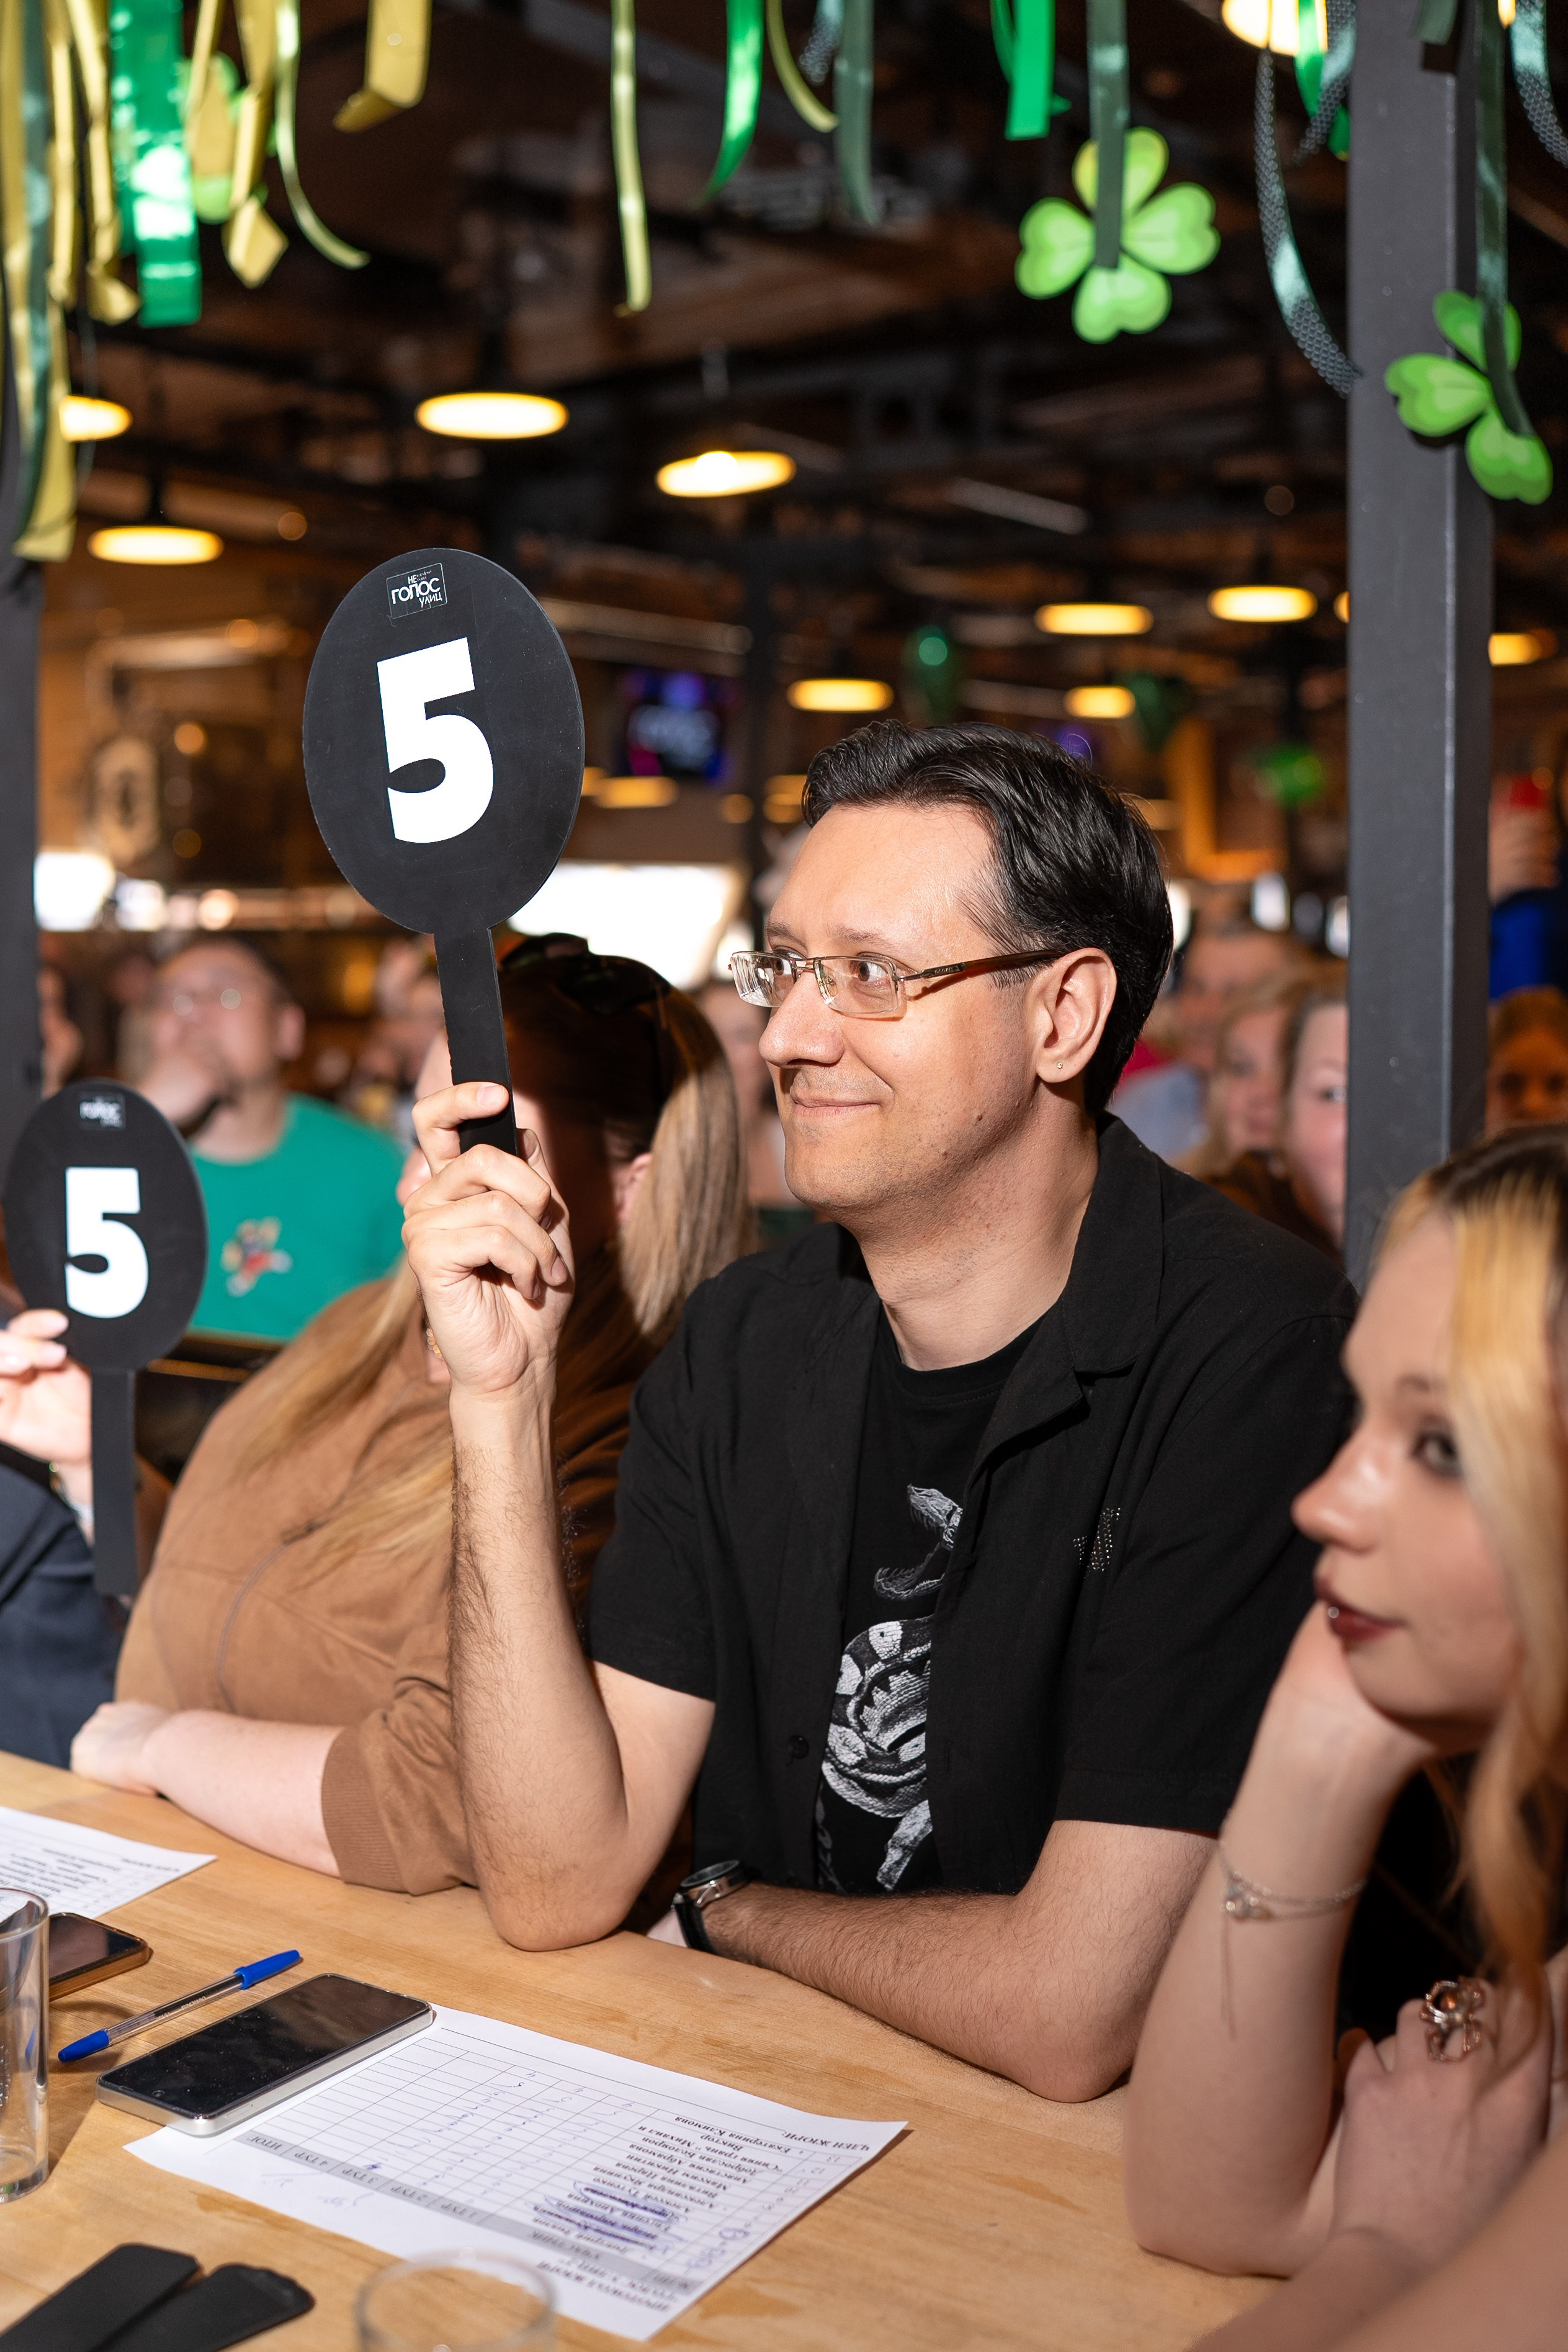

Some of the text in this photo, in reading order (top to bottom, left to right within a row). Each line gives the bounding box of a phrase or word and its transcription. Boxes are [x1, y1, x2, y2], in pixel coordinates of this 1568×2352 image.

[407, 574, 418, 585] НЕ
[418, 592, 443, 608] УЛИЦ
[377, 637, 494, 844] 5
[64, 1167, 148, 1319] 5
[648, 2129, 694, 2147] Михаил
[675, 2117, 791, 2153] Екатерина Климова
[701, 2135, 743, 2151] Виктор
[781, 2131, 869, 2150] ЧЛЕН ЖЮРИ:
